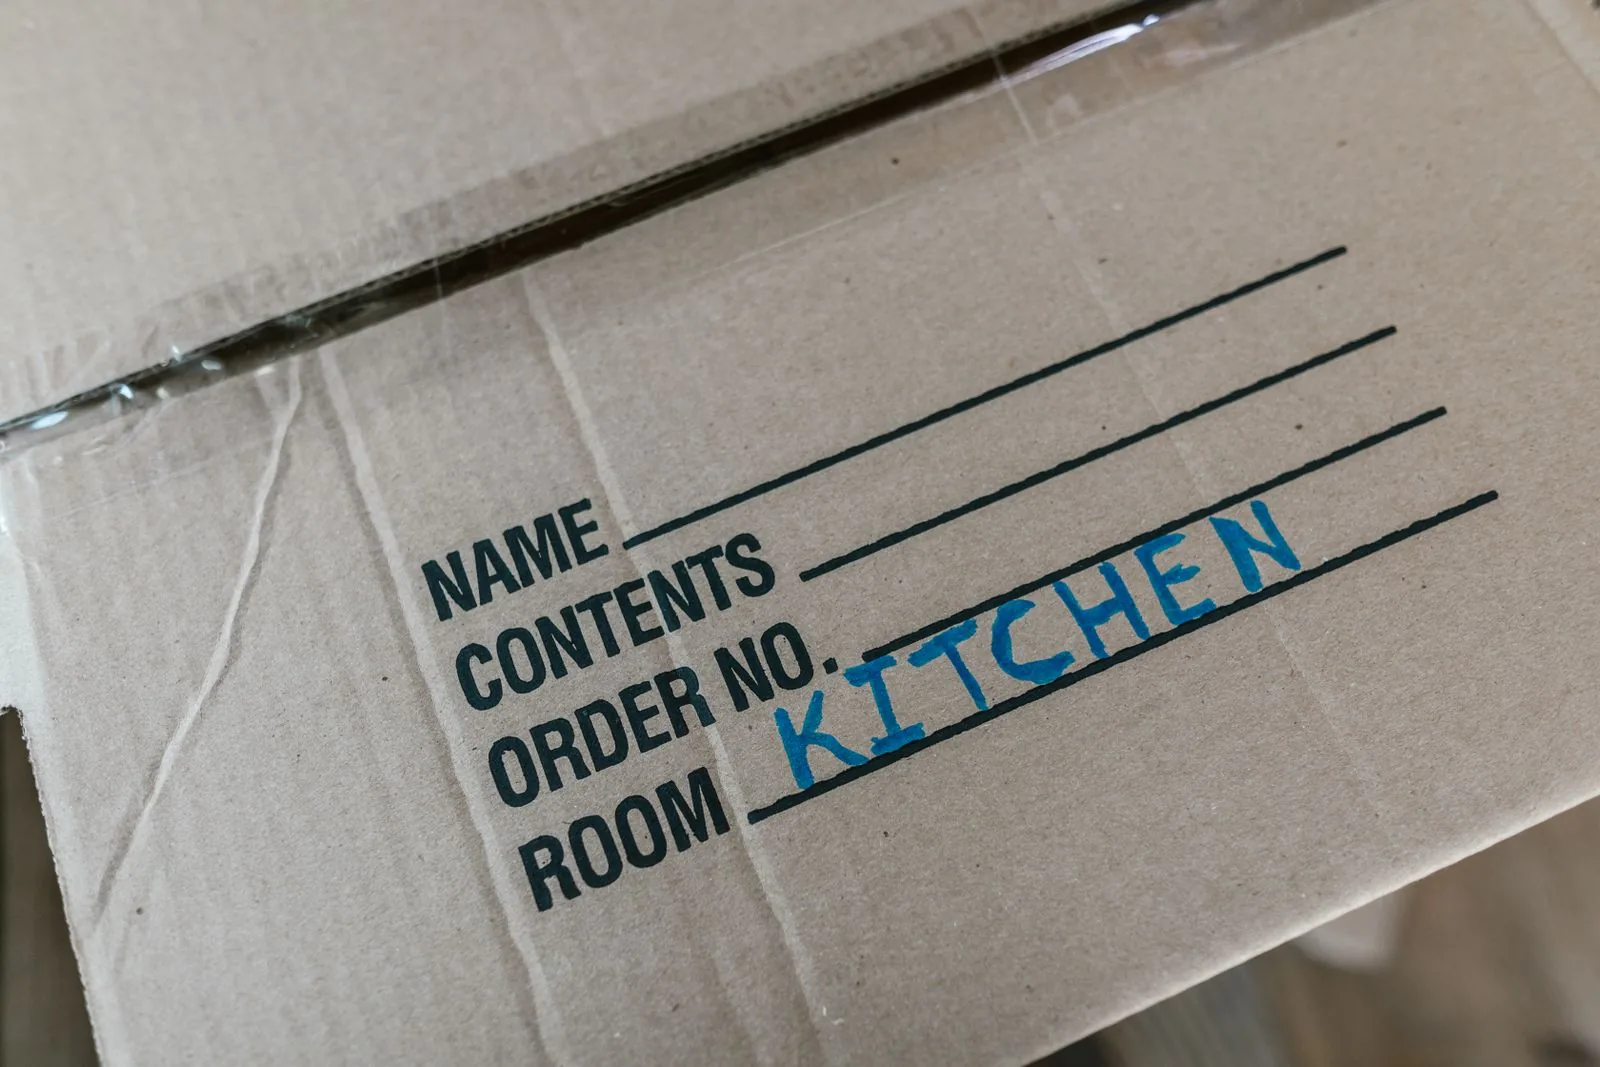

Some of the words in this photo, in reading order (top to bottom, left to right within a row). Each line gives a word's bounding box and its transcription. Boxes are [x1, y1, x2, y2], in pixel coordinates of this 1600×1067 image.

[421, 498, 609, 621] NAME
[456, 533, 775, 711] CONTENTS
[773, 500, 1301, 791] KITCHEN
[489, 667, 716, 807] ORDER
[714, 622, 838, 712] NO.
[518, 767, 730, 912] ROOM
